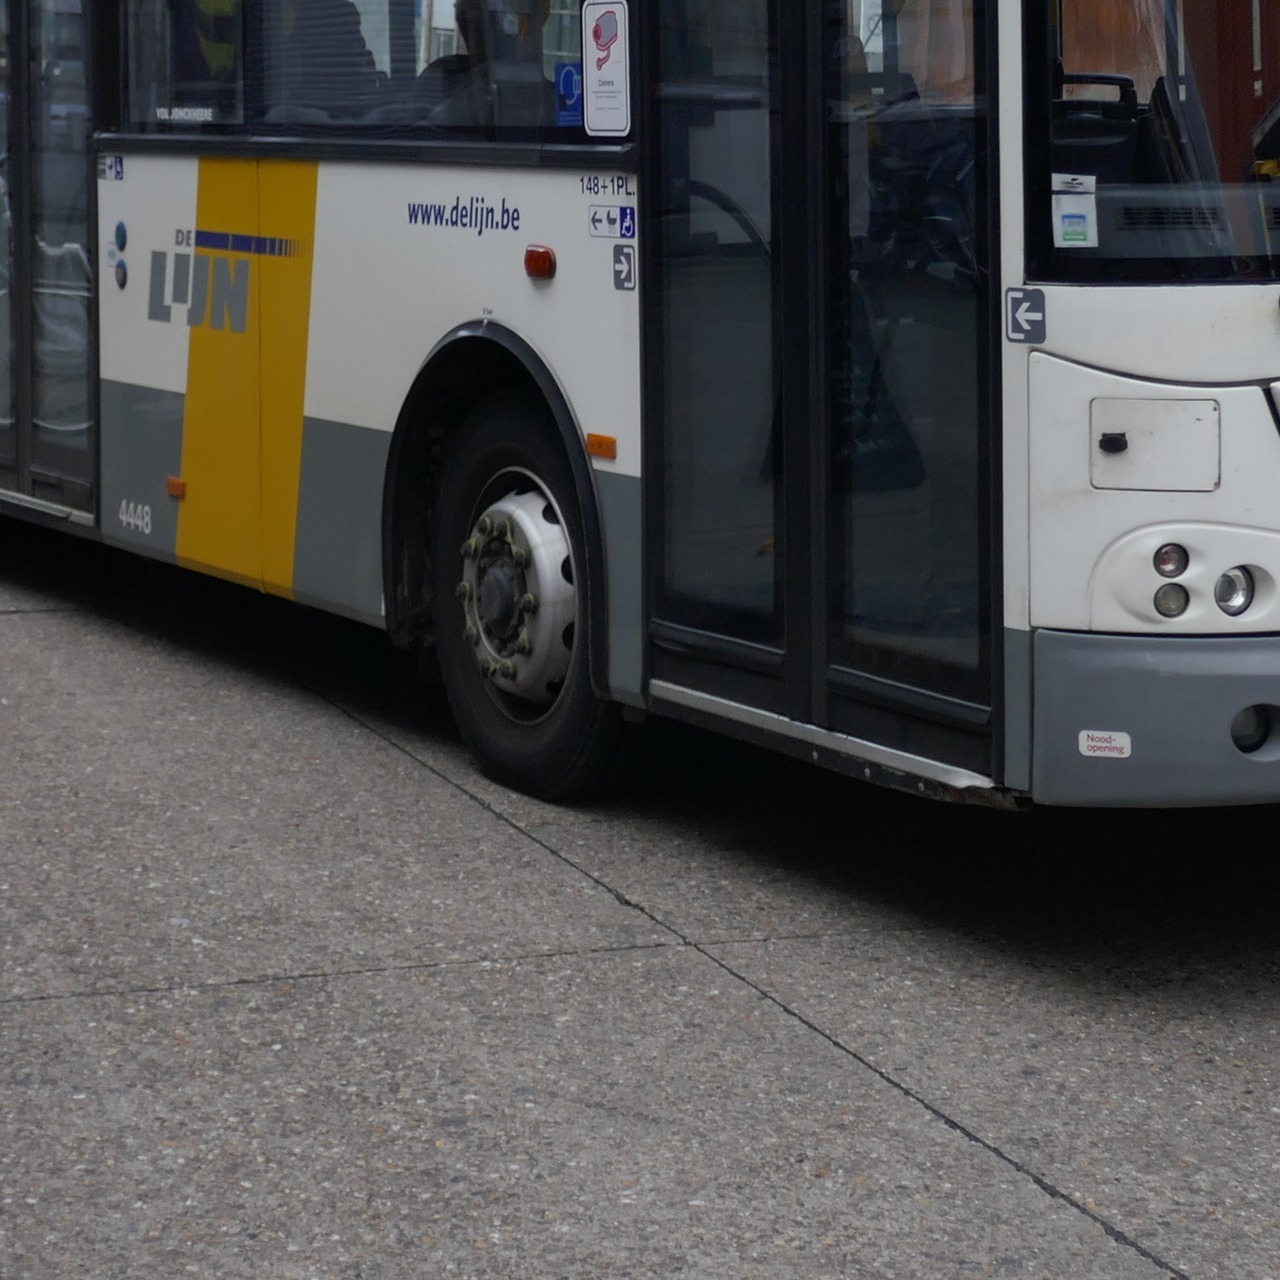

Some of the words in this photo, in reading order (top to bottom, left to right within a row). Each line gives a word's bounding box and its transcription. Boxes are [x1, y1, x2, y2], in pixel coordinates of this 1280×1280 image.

[579, 176, 636, 196] 148+1PL.
[407, 195, 521, 237] www.delijn.be
[174, 228, 192, 247] DE
[147, 250, 251, 335] LIJN
[119, 499, 151, 535] 4448
[1086, 733, 1116, 744] Nood-
[1086, 744, 1125, 755] opening
